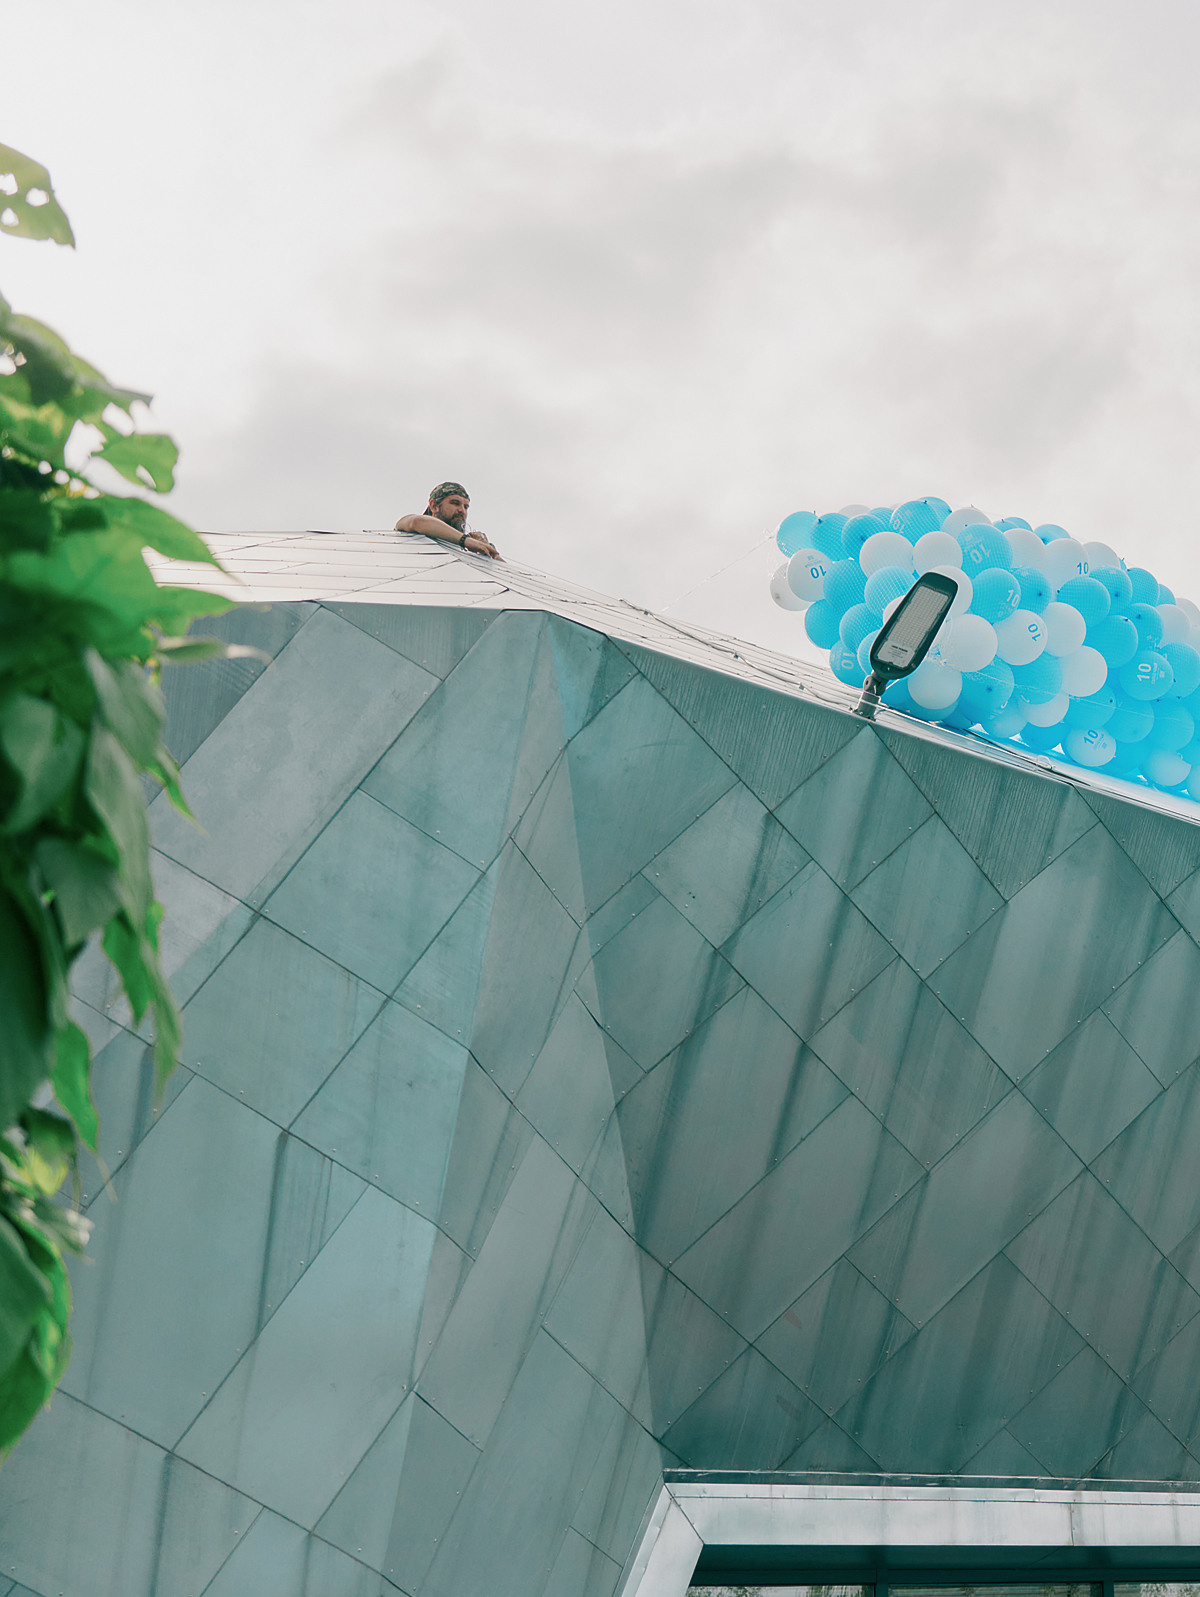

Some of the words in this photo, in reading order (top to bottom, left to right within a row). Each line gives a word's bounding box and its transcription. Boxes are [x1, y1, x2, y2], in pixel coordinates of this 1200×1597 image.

[970, 544, 991, 564] 10
[810, 565, 826, 580] 10
[1077, 562, 1089, 575] 10
[1007, 590, 1020, 607] 10
[1028, 623, 1040, 642] 10
[841, 651, 855, 670] 10
[1137, 663, 1152, 682] 10
[1084, 730, 1098, 745] 10
